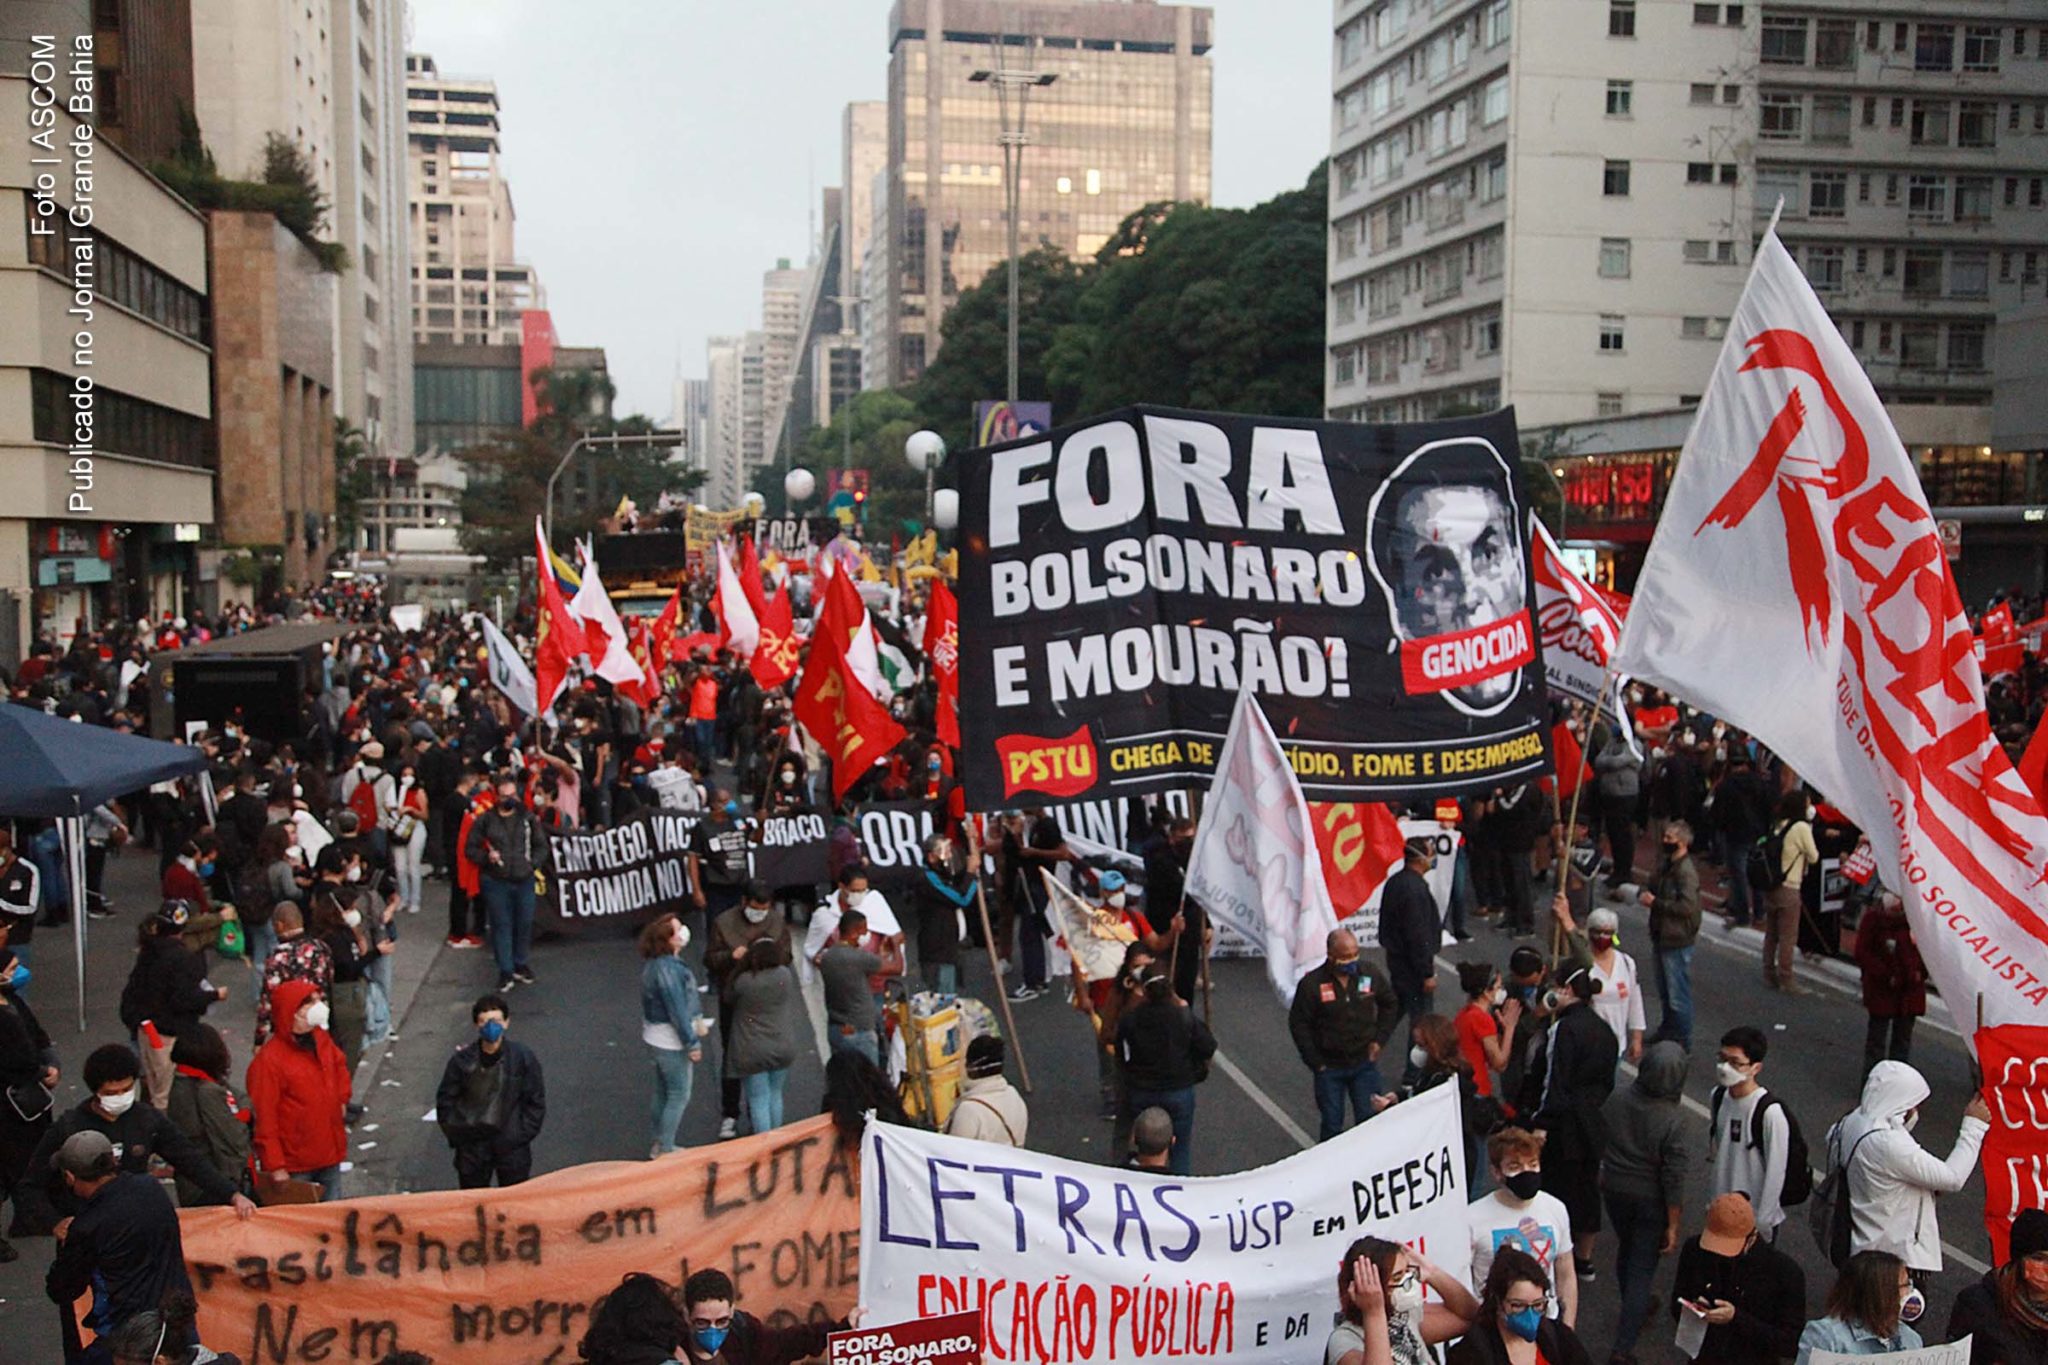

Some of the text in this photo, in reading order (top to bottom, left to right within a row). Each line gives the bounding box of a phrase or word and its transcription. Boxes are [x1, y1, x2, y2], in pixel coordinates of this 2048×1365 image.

[988, 414, 1346, 548] FORA
[754, 518, 810, 549] FORA
[991, 533, 1366, 617] BOLSONARO
[993, 617, 1351, 707] E MOURÃO!
[1422, 619, 1529, 680] GENOCIDA
[1008, 743, 1091, 785] PSTU
[1110, 741, 1183, 772] CHEGA
[1187, 741, 1214, 766] DE
[1353, 752, 1416, 777] FOME
[1423, 752, 1434, 774] E
[550, 820, 654, 873] EMPREGO,
[763, 813, 827, 848] BRAÇO
[558, 878, 573, 918] E
[574, 866, 657, 917] COMIDA
[654, 858, 684, 901] NO
[1921, 885, 2048, 1007] SOCIALISTA
[194, 1136, 855, 1292] rasilândia em LUTA
[873, 1134, 1200, 1263] LETRAS
[1312, 1215, 1346, 1237] EM
[1352, 1145, 1455, 1225] DEFESA
[732, 1228, 860, 1298] FOME
[252, 1299, 601, 1365] Nem morr
[832, 1332, 895, 1356] FORA
[833, 1335, 977, 1365] BOLSONARO,
[1256, 1321, 1268, 1347] E
[1284, 1312, 1309, 1341] DA
